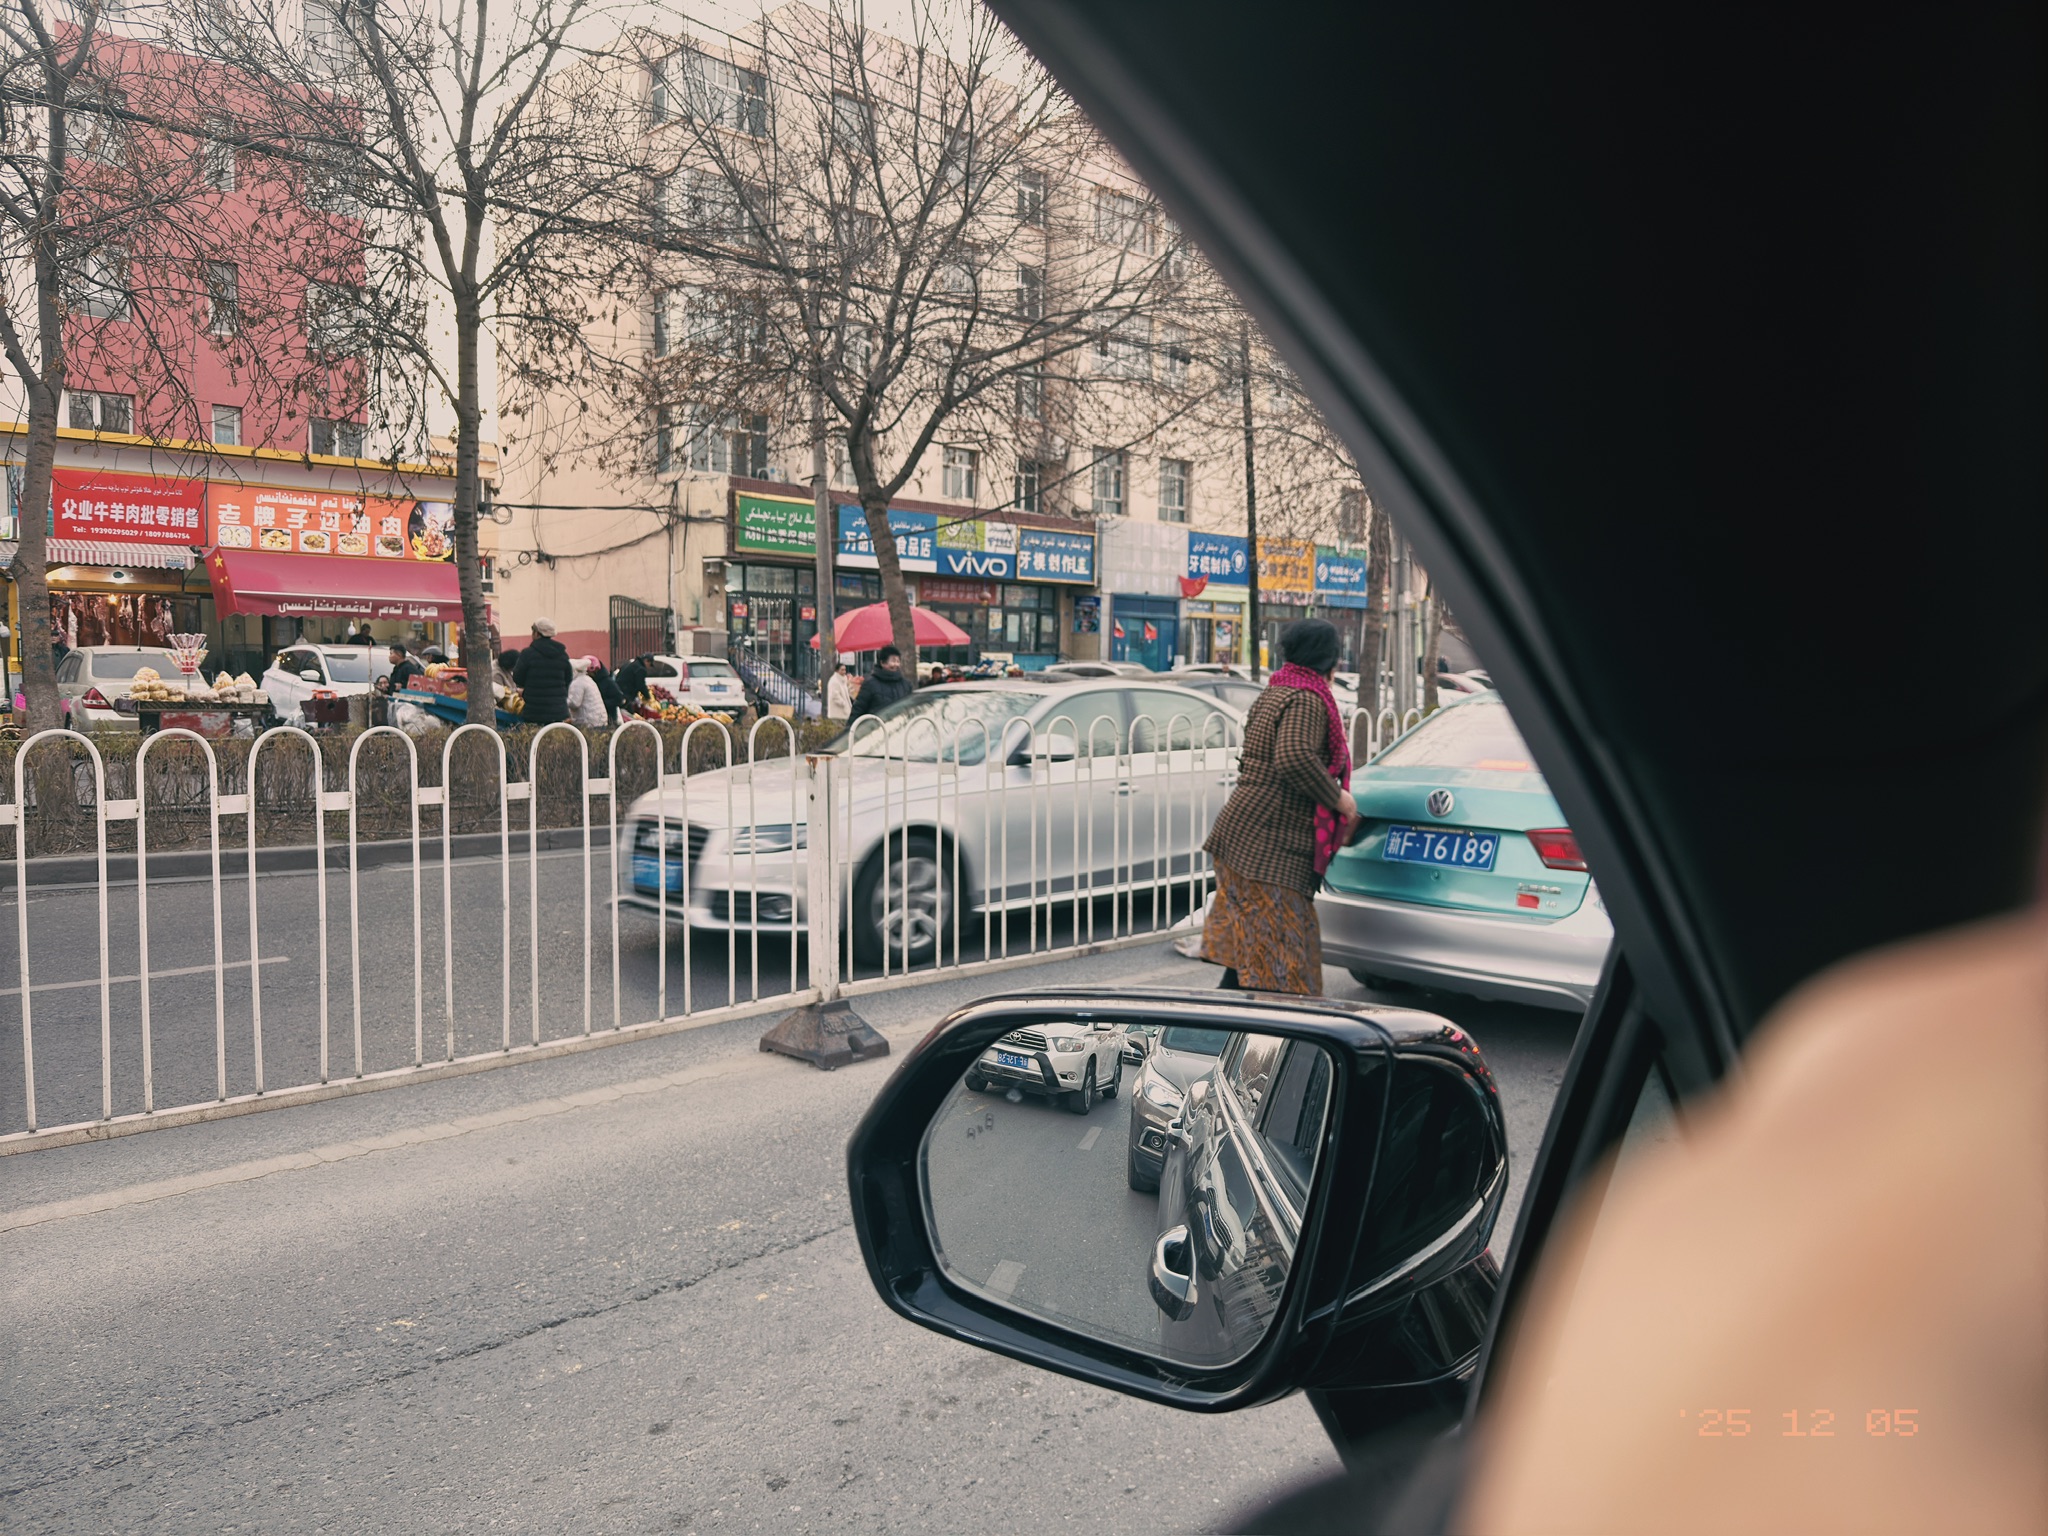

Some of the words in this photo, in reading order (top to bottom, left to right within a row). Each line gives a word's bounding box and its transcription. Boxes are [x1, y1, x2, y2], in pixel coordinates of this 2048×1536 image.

[61, 498, 199, 528] 父业牛羊肉批零销售
[90, 527, 138, 537] 19390295029
